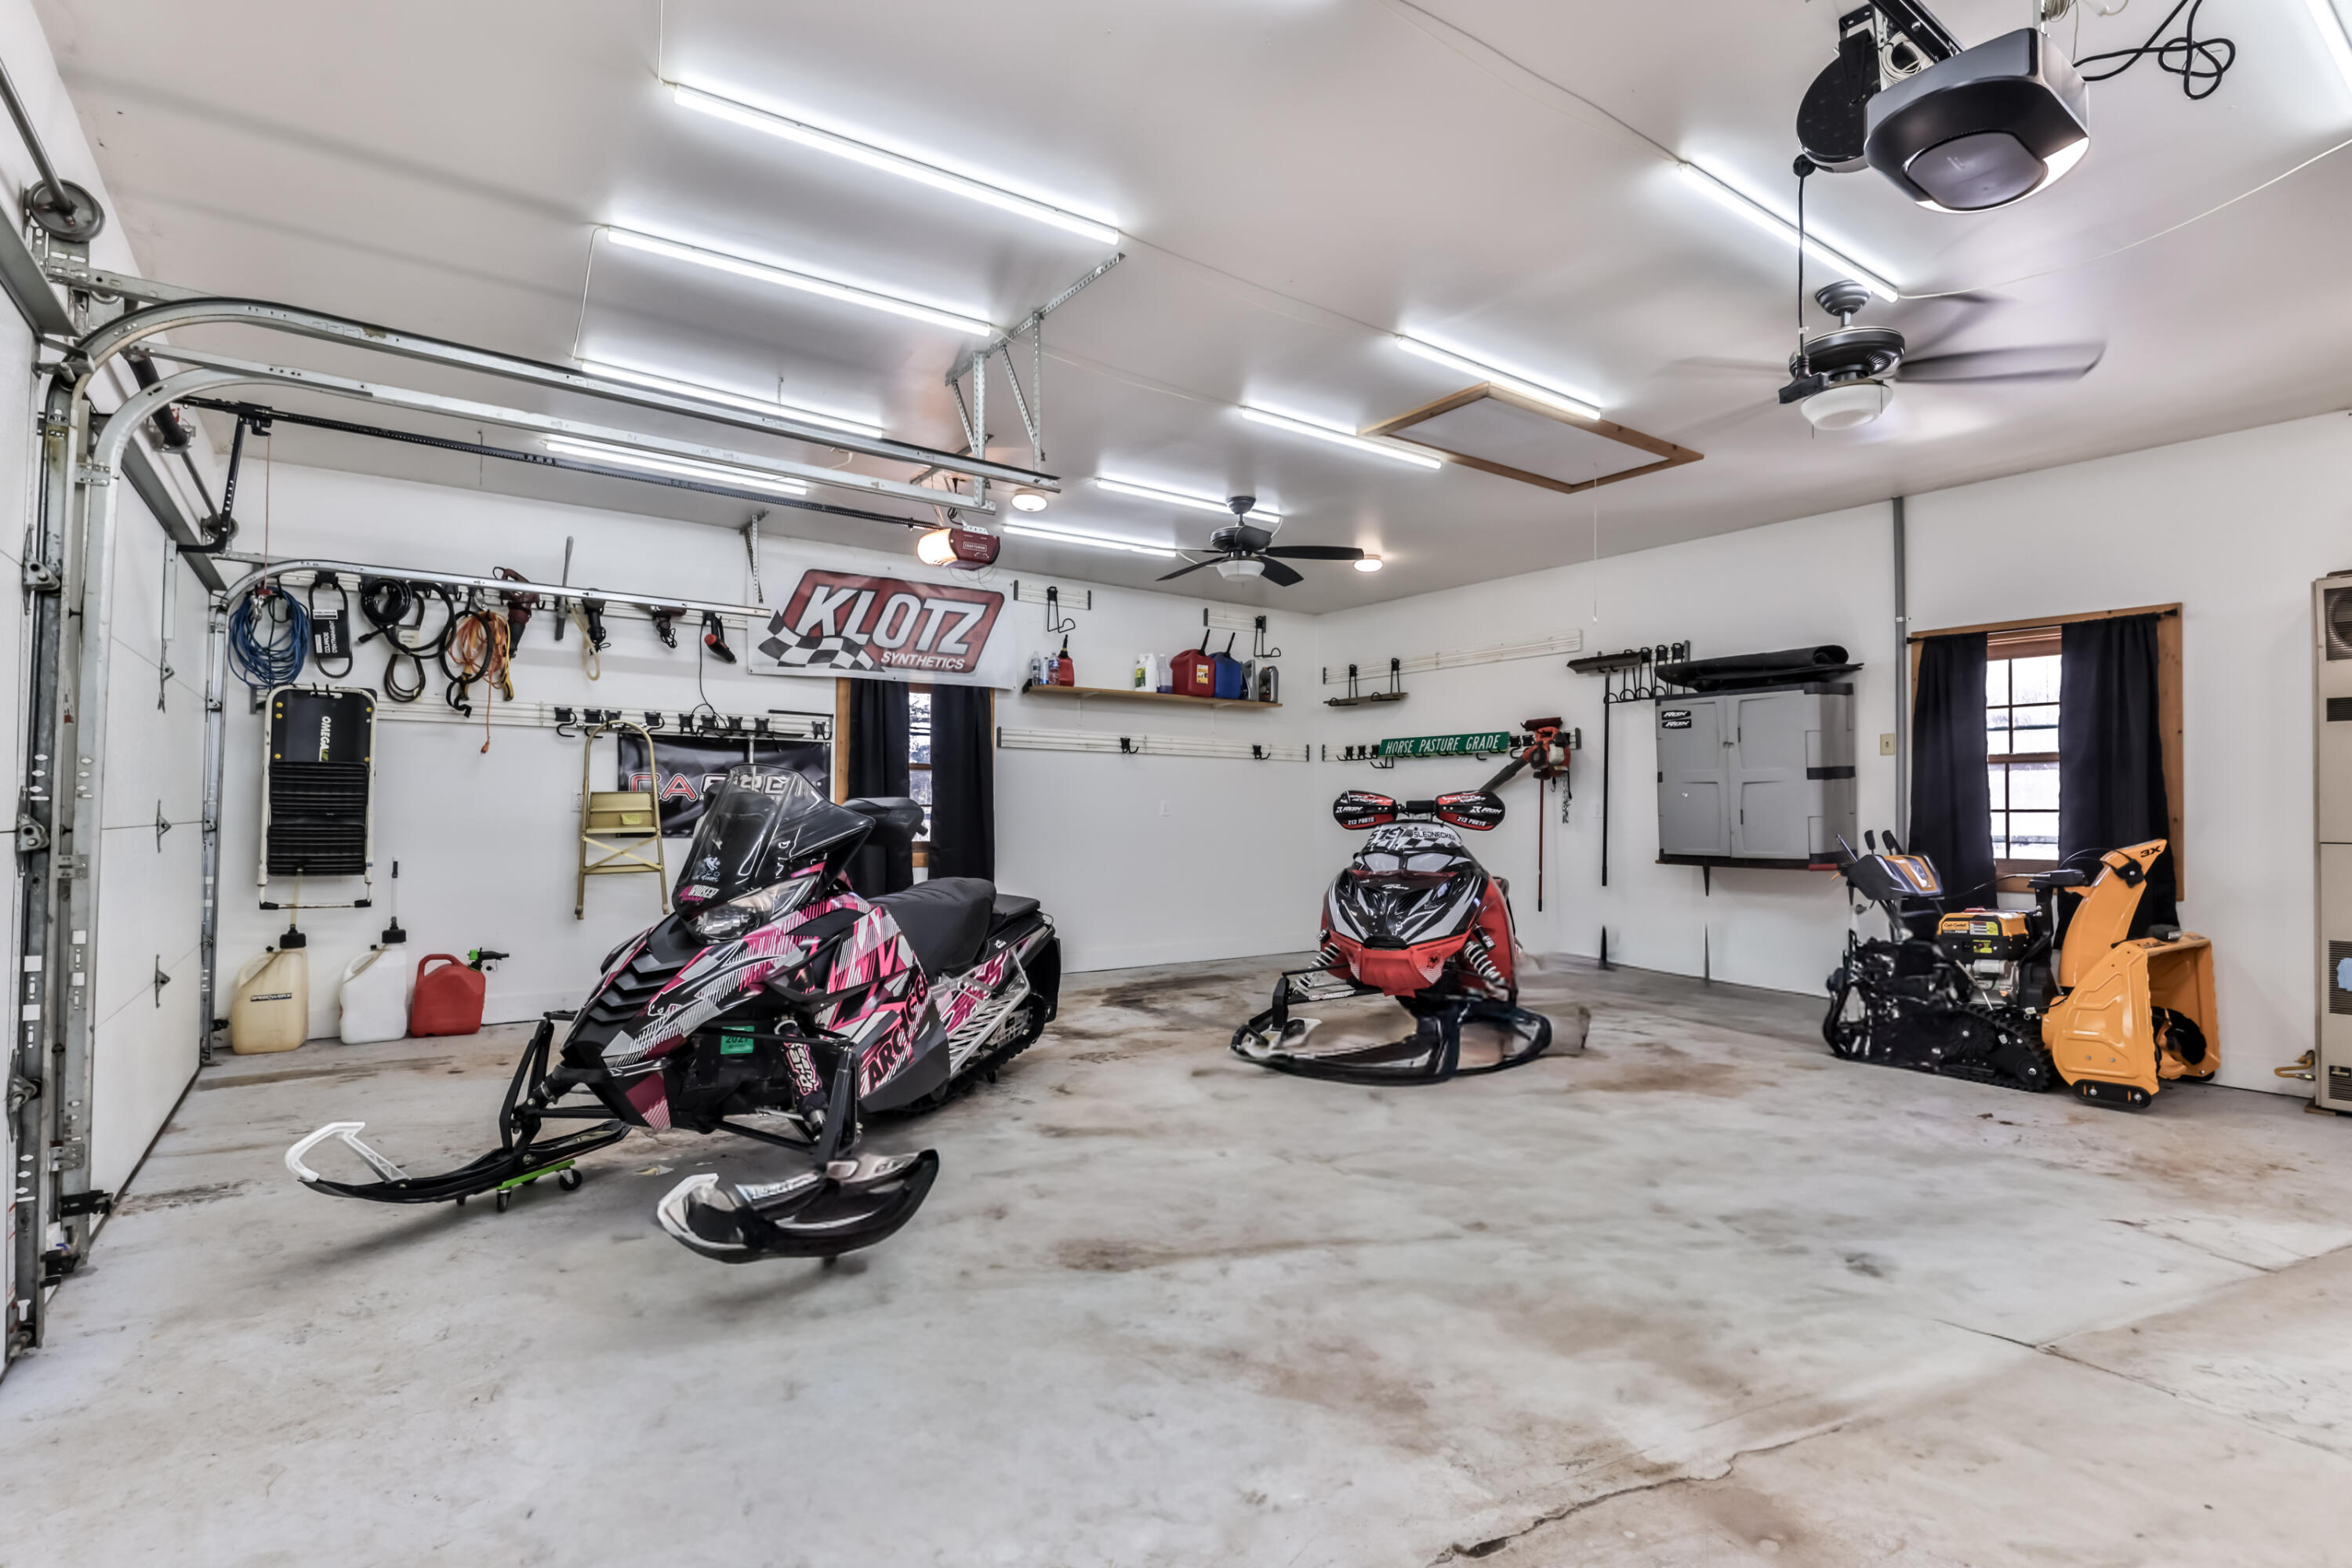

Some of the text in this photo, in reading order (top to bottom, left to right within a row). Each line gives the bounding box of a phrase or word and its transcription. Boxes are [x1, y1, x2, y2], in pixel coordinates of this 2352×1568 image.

[794, 585, 987, 655] KLOTZ
[880, 650, 965, 670] SYNTHETICS
[1385, 735, 1501, 754] HORSE PASTURE GRADE
